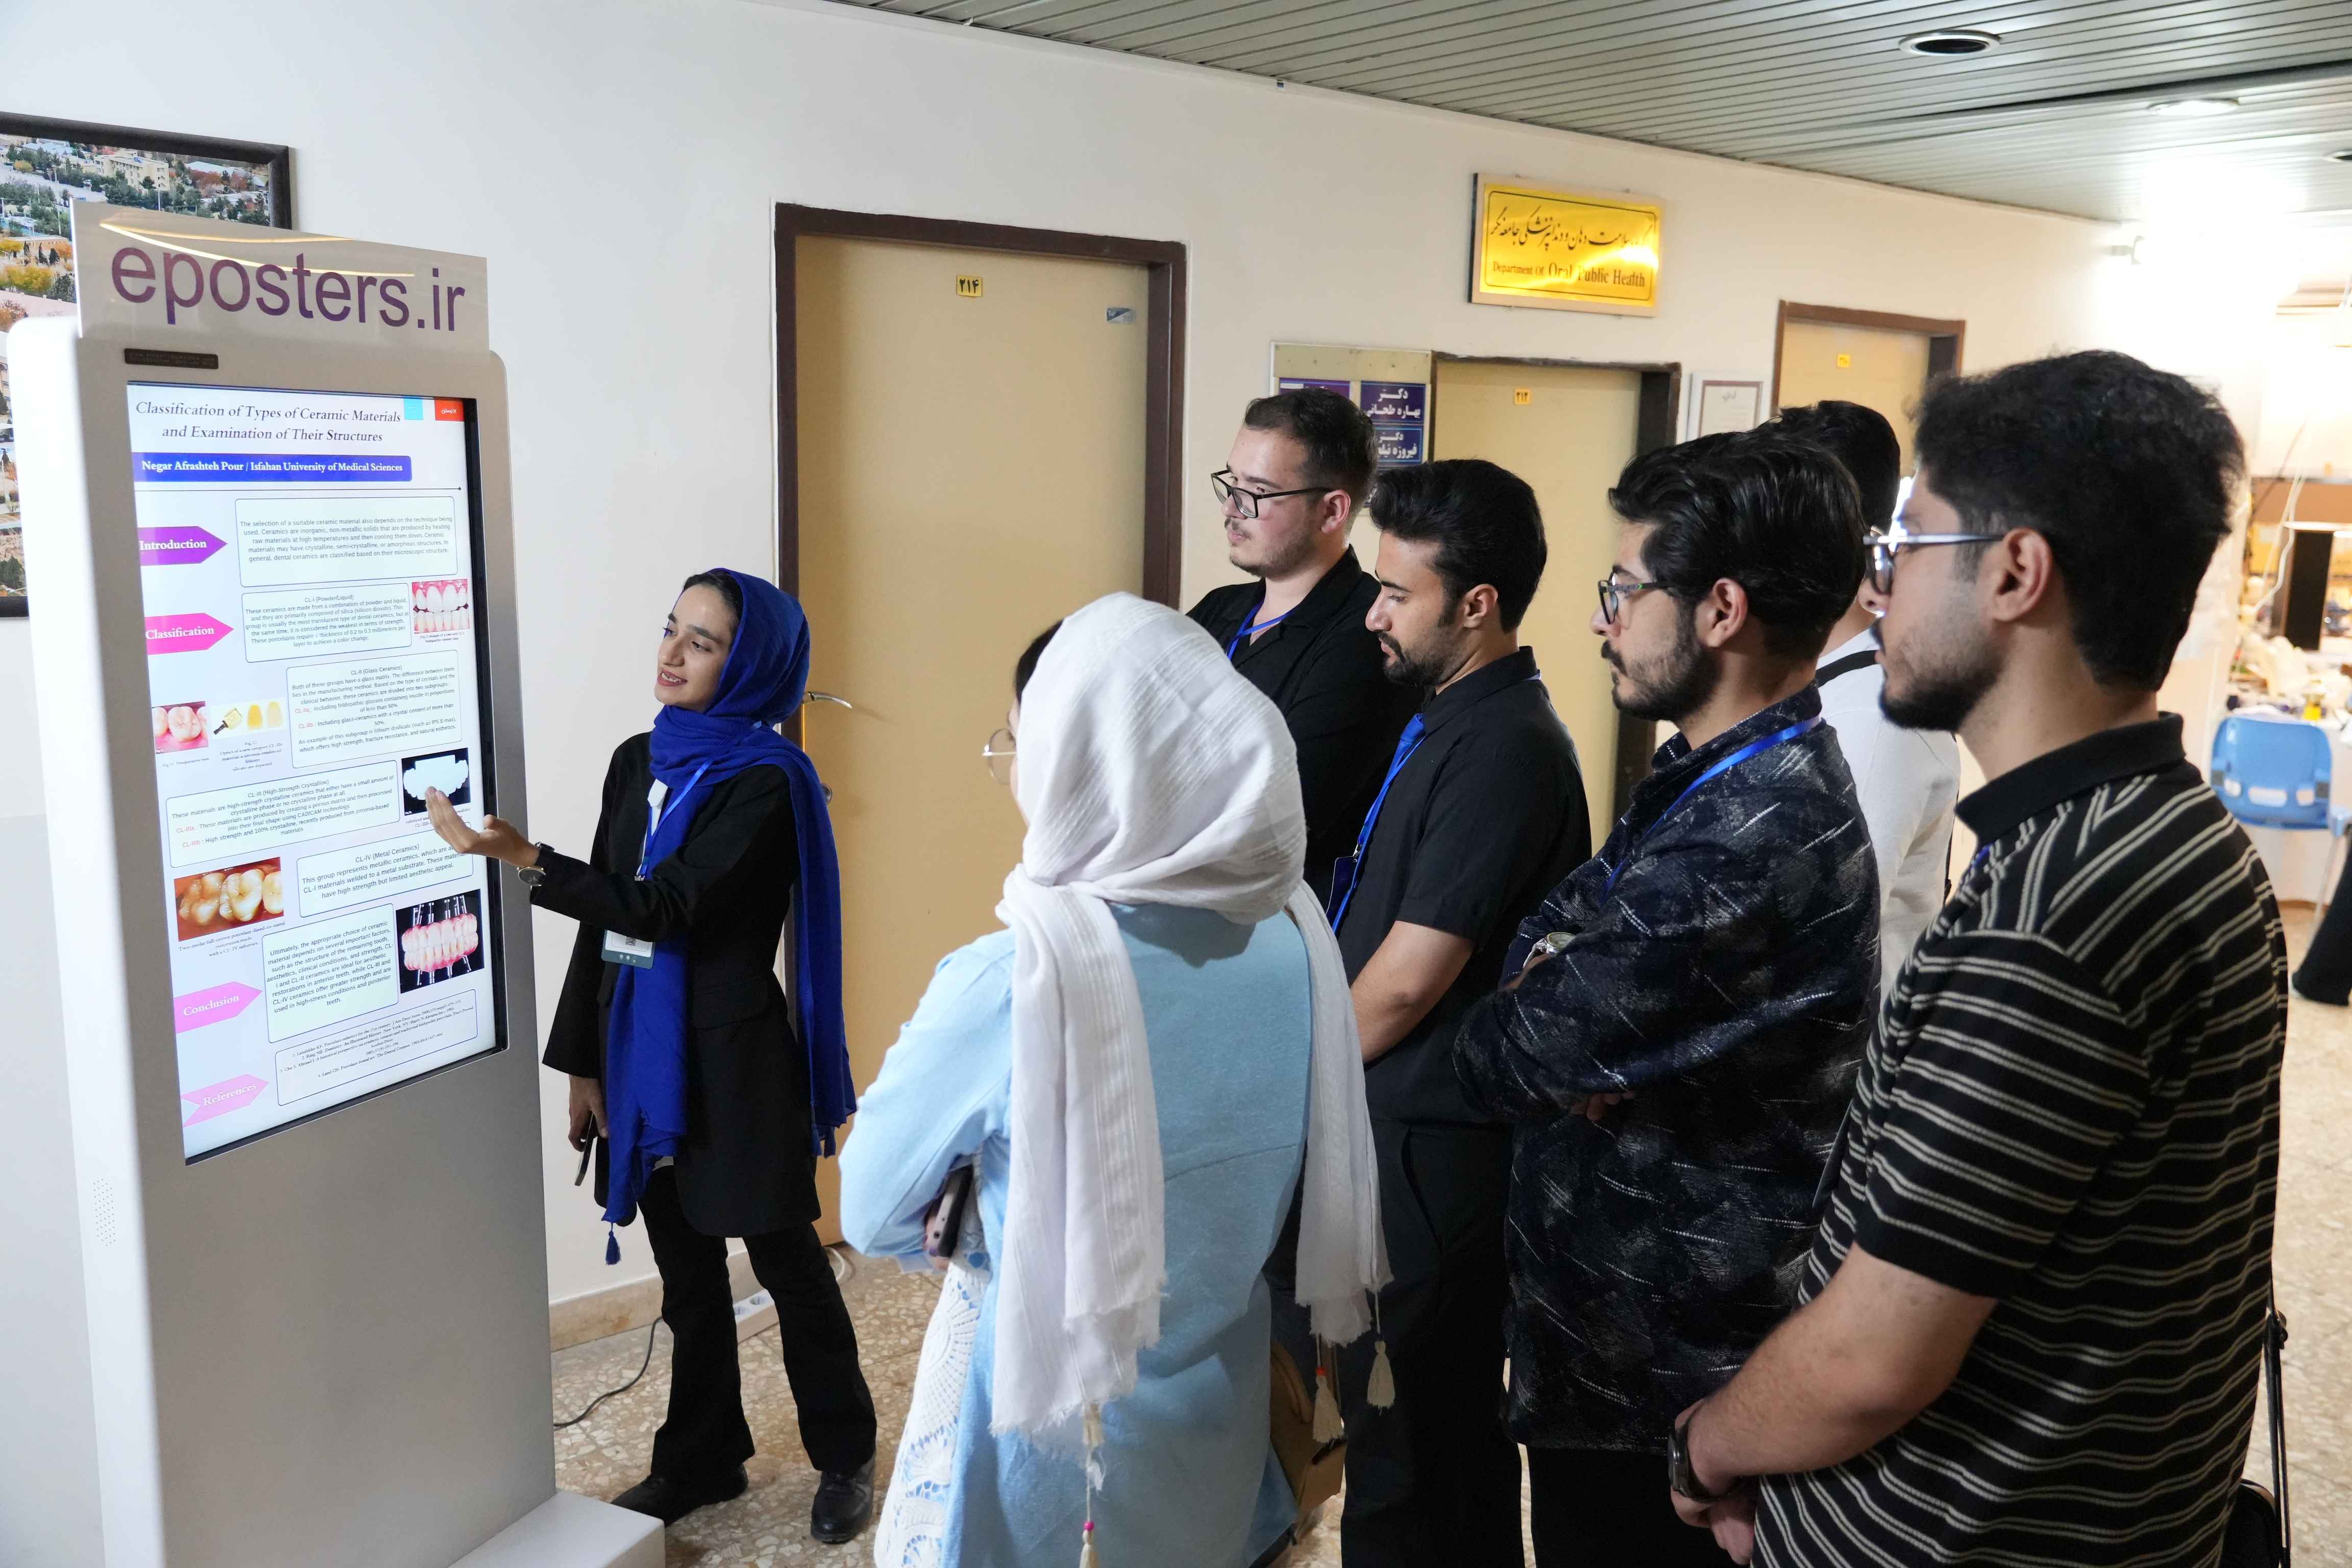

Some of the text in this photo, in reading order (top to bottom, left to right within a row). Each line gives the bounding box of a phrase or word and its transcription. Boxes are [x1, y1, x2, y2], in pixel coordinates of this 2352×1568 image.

[1493, 261, 1533, 275] Department
[1549, 262, 1572, 279] Oral
[1578, 265, 1609, 284] Public
[1613, 270, 1645, 287] Health
[112, 247, 465, 332] eposters.ir
[960, 278, 979, 294] ۲۱۴
[1378, 388, 1408, 402] دکتر
[136, 402, 400, 421] Classification of Types of Ceramic Materials
[162, 425, 382, 440] and Examination of Their Structures
[1379, 432, 1404, 443] دکتر
[141, 460, 172, 472] Negar
[174, 460, 219, 470] Afrashteh
[221, 461, 244, 470] Pour
[246, 462, 248, 471] /
[250, 461, 282, 470] Isfahan
[283, 462, 326, 473] University
[139, 539, 207, 551] Introduction
[146, 625, 215, 641] Classification
[263, 784, 300, 796] (High-Strength
[301, 779, 329, 788] Crystalline)
[355, 844, 419, 862] CL-IV (Metal Ceramics)
[317, 873, 335, 882] group
[337, 865, 368, 877] represents
[370, 860, 391, 868] metallic
[421, 848, 437, 856] which
[317, 879, 345, 889] materials
[347, 873, 367, 883] welded
[381, 866, 396, 874] metal
[352, 880, 376, 891] strength
[389, 872, 407, 882] limited
[409, 867, 434, 877] aesthetic
[311, 934, 341, 945] appropriate
[368, 921, 388, 929] ceramic
[267, 954, 290, 965] material
[292, 948, 315, 958] depends
[325, 940, 344, 949] several
[346, 933, 370, 943] important
[305, 953, 329, 963] structure
[347, 941, 373, 951] remaining
[298, 963, 317, 973] clinical
[305, 969, 330, 979] ceramics
[341, 961, 353, 969] ideal
[363, 952, 387, 963] aesthetic
[272, 984, 305, 997] restorations
[313, 975, 334, 985] anterior
[366, 961, 380, 969] CL-III
[273, 996, 288, 1004] CL-IV
[289, 990, 314, 1000] ceramics
[330, 979, 348, 989] greater
[350, 972, 371, 982] strength
[184, 994, 239, 1017] Conclusion
[274, 1004, 288, 1013] used
[296, 994, 327, 1006] high-stress
[328, 985, 355, 996] conditions
[368, 975, 390, 986] posterior
[203, 1082, 257, 1108] References
